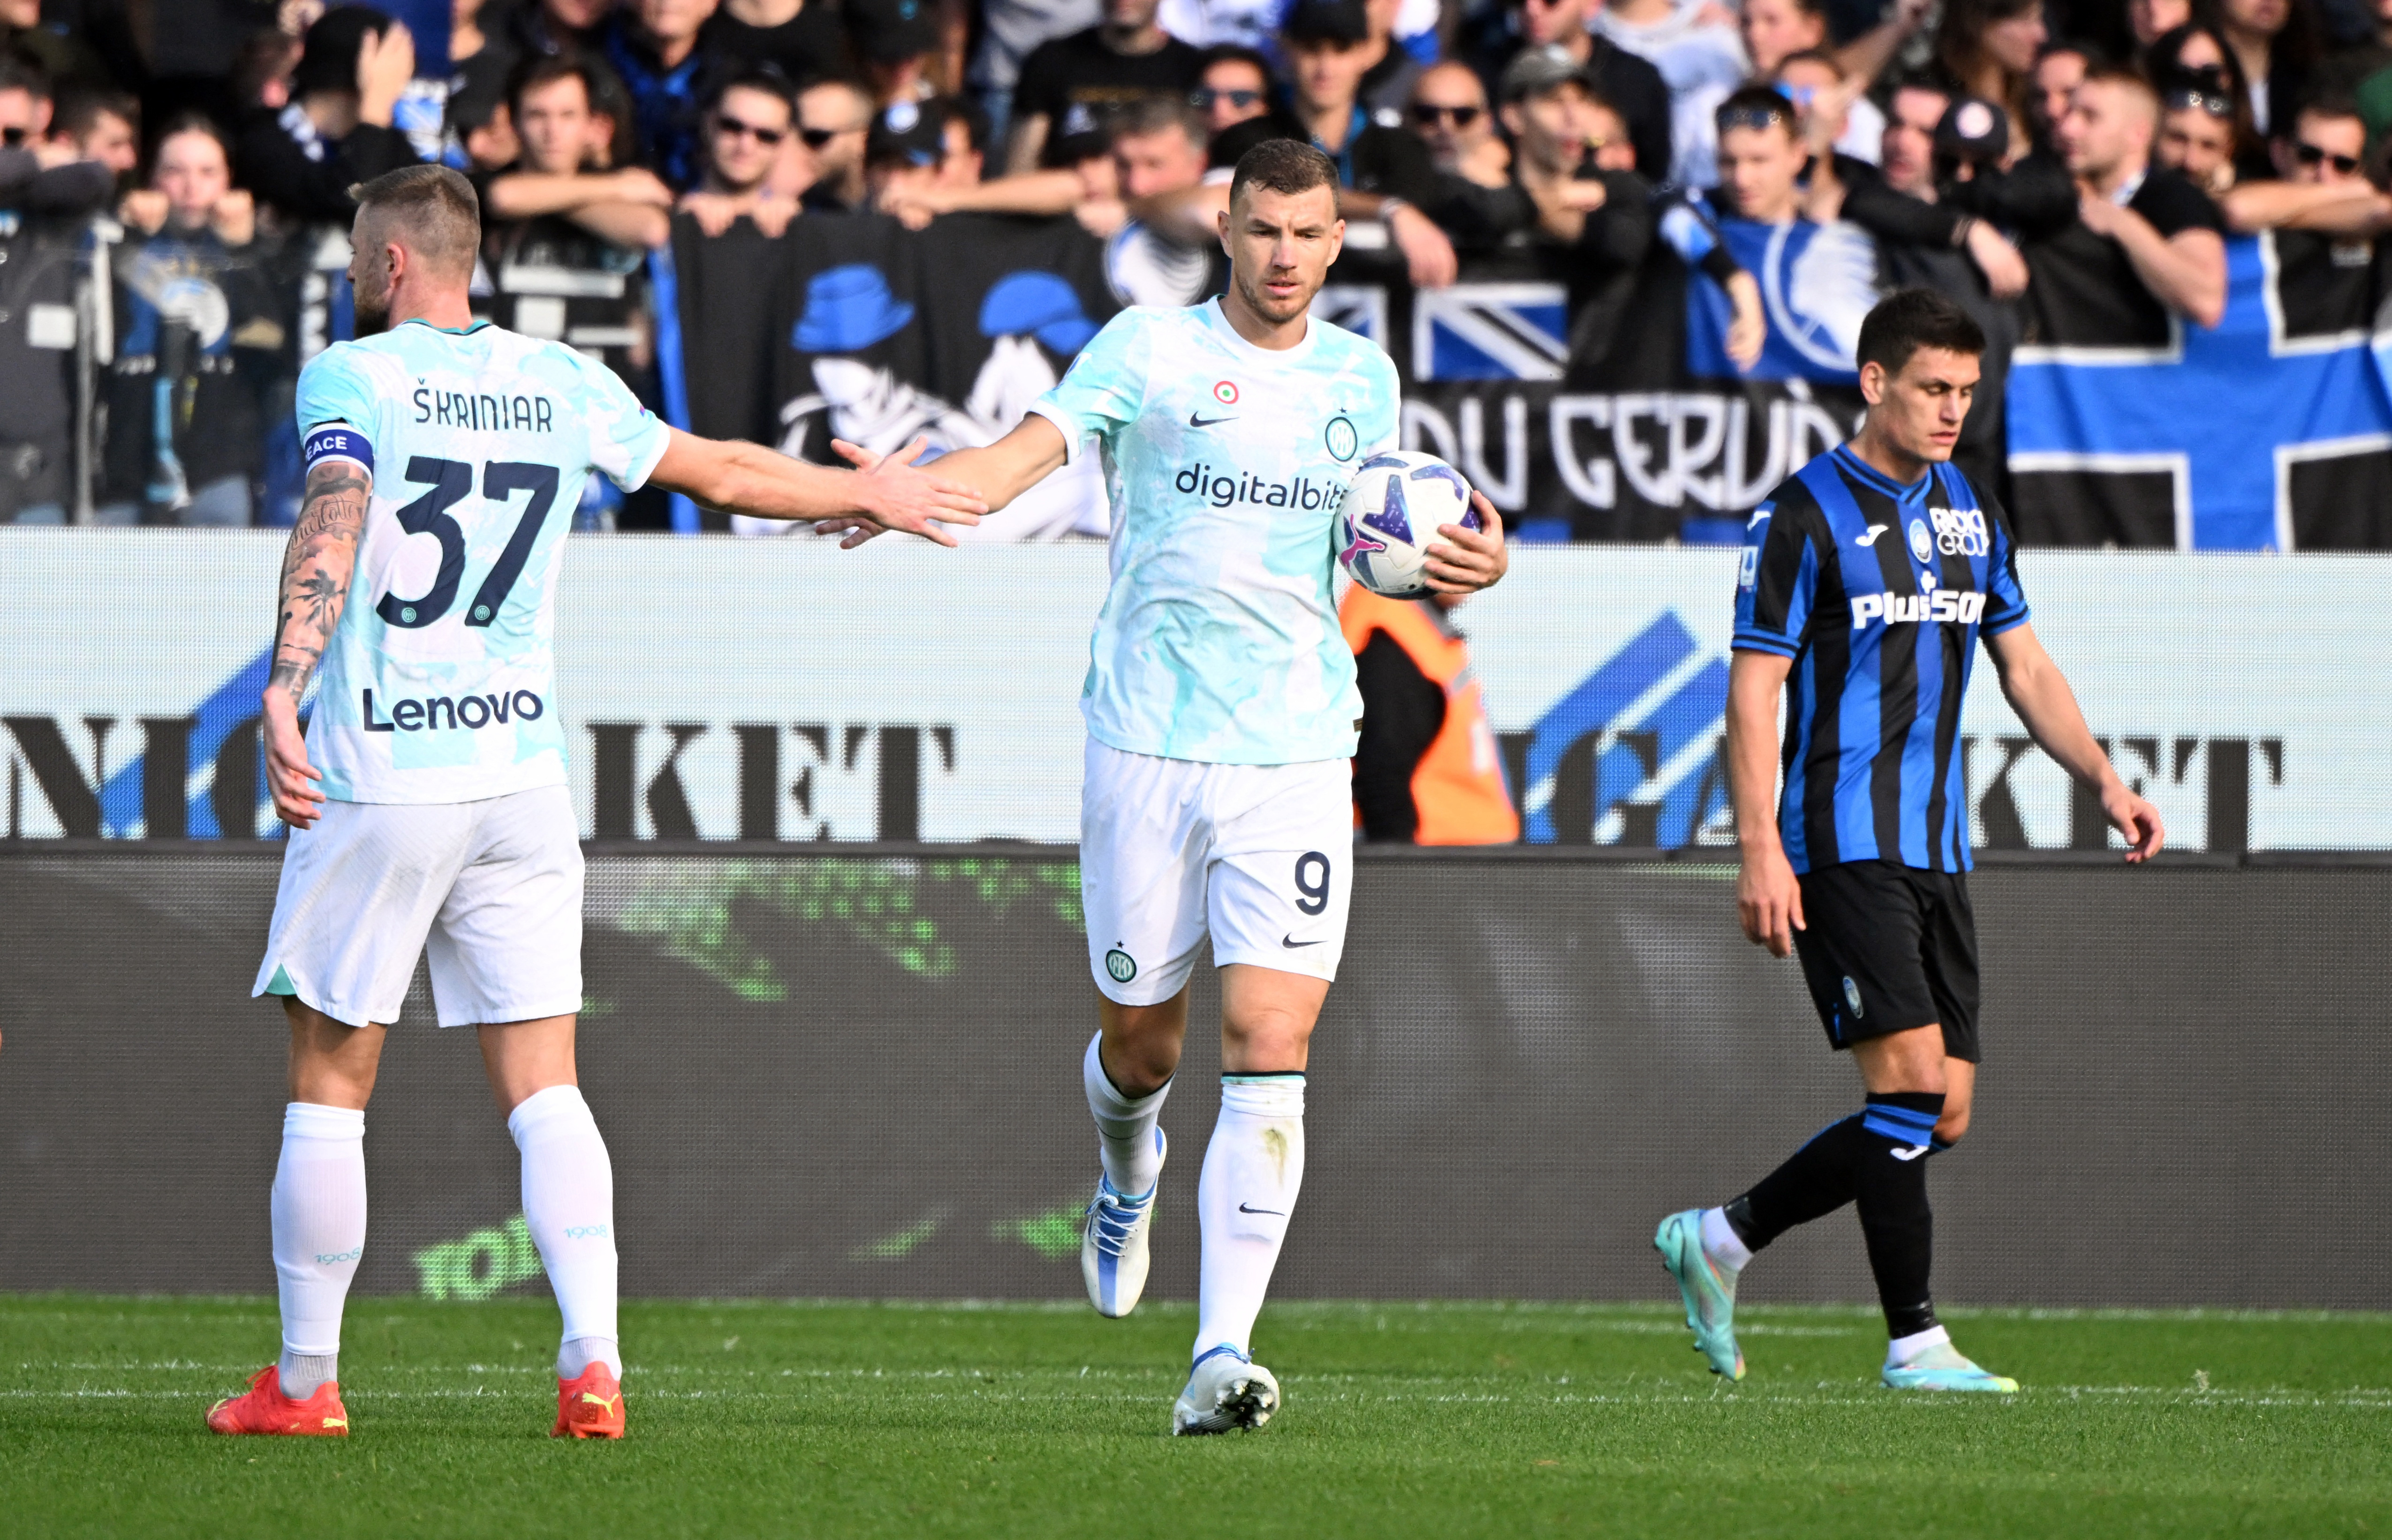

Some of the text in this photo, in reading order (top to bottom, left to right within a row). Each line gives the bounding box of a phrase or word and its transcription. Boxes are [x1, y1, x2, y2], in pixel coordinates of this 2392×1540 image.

[413, 378, 553, 432] ŠKRINIAR
[306, 436, 348, 462] EACE
[376, 455, 560, 628] 37
[363, 688, 544, 732] Lenovo
[1294, 851, 1330, 916] 9
[564, 1224, 608, 1238] 1908
[315, 1247, 361, 1266] 1908
